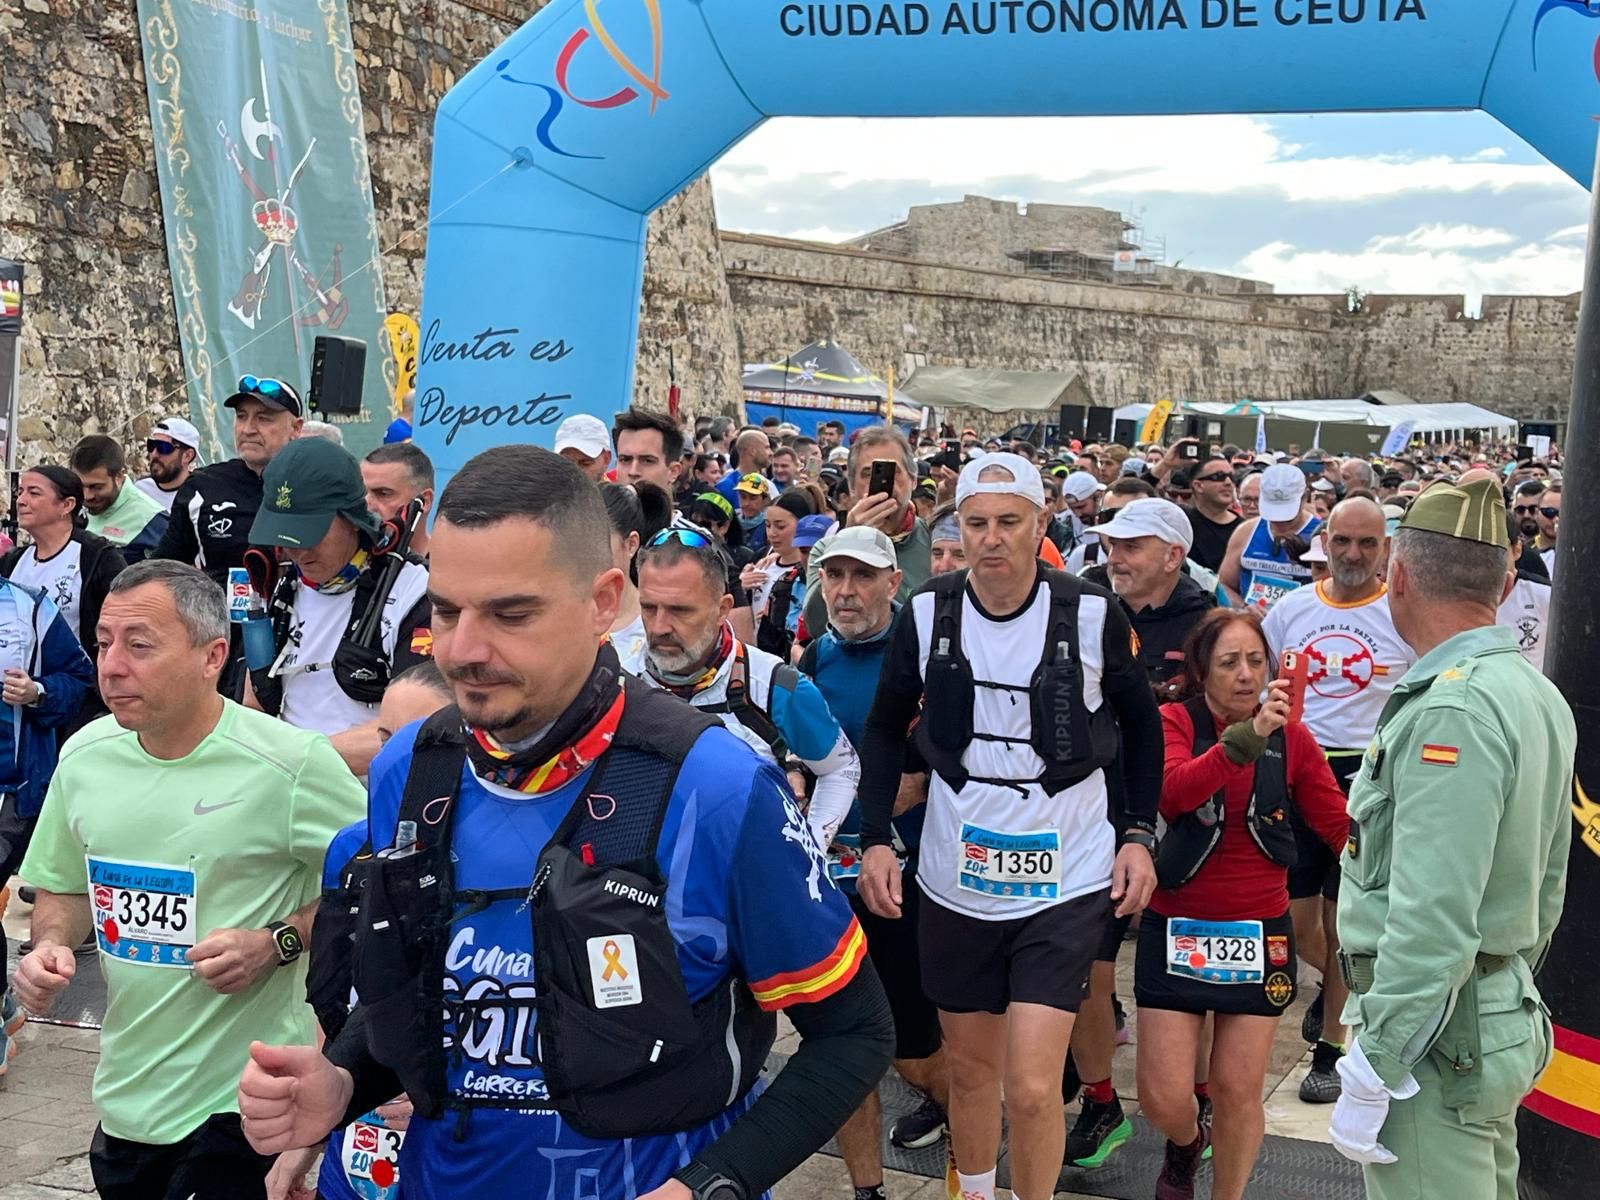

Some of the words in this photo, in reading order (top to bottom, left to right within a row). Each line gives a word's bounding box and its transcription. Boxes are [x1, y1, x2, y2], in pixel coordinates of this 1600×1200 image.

[779, 3, 929, 37] CIUDAD
[1200, 0, 1259, 29] DE
[421, 318, 519, 367] Ceuta
[529, 338, 574, 362] es
[419, 386, 572, 447] Deporte
[1298, 630, 1317, 647] TODO
[1320, 624, 1336, 633] POR
[1339, 623, 1351, 631] LA
[1353, 627, 1378, 655] PATRIA
[1054, 680, 1073, 761] KIPRUN
[965, 860, 989, 876] 20K
[993, 850, 1053, 875] 1350
[118, 890, 188, 932] 3345
[604, 879, 659, 908] KIPRUN
[444, 926, 532, 978] Cuna
[1202, 937, 1256, 962] 1328
